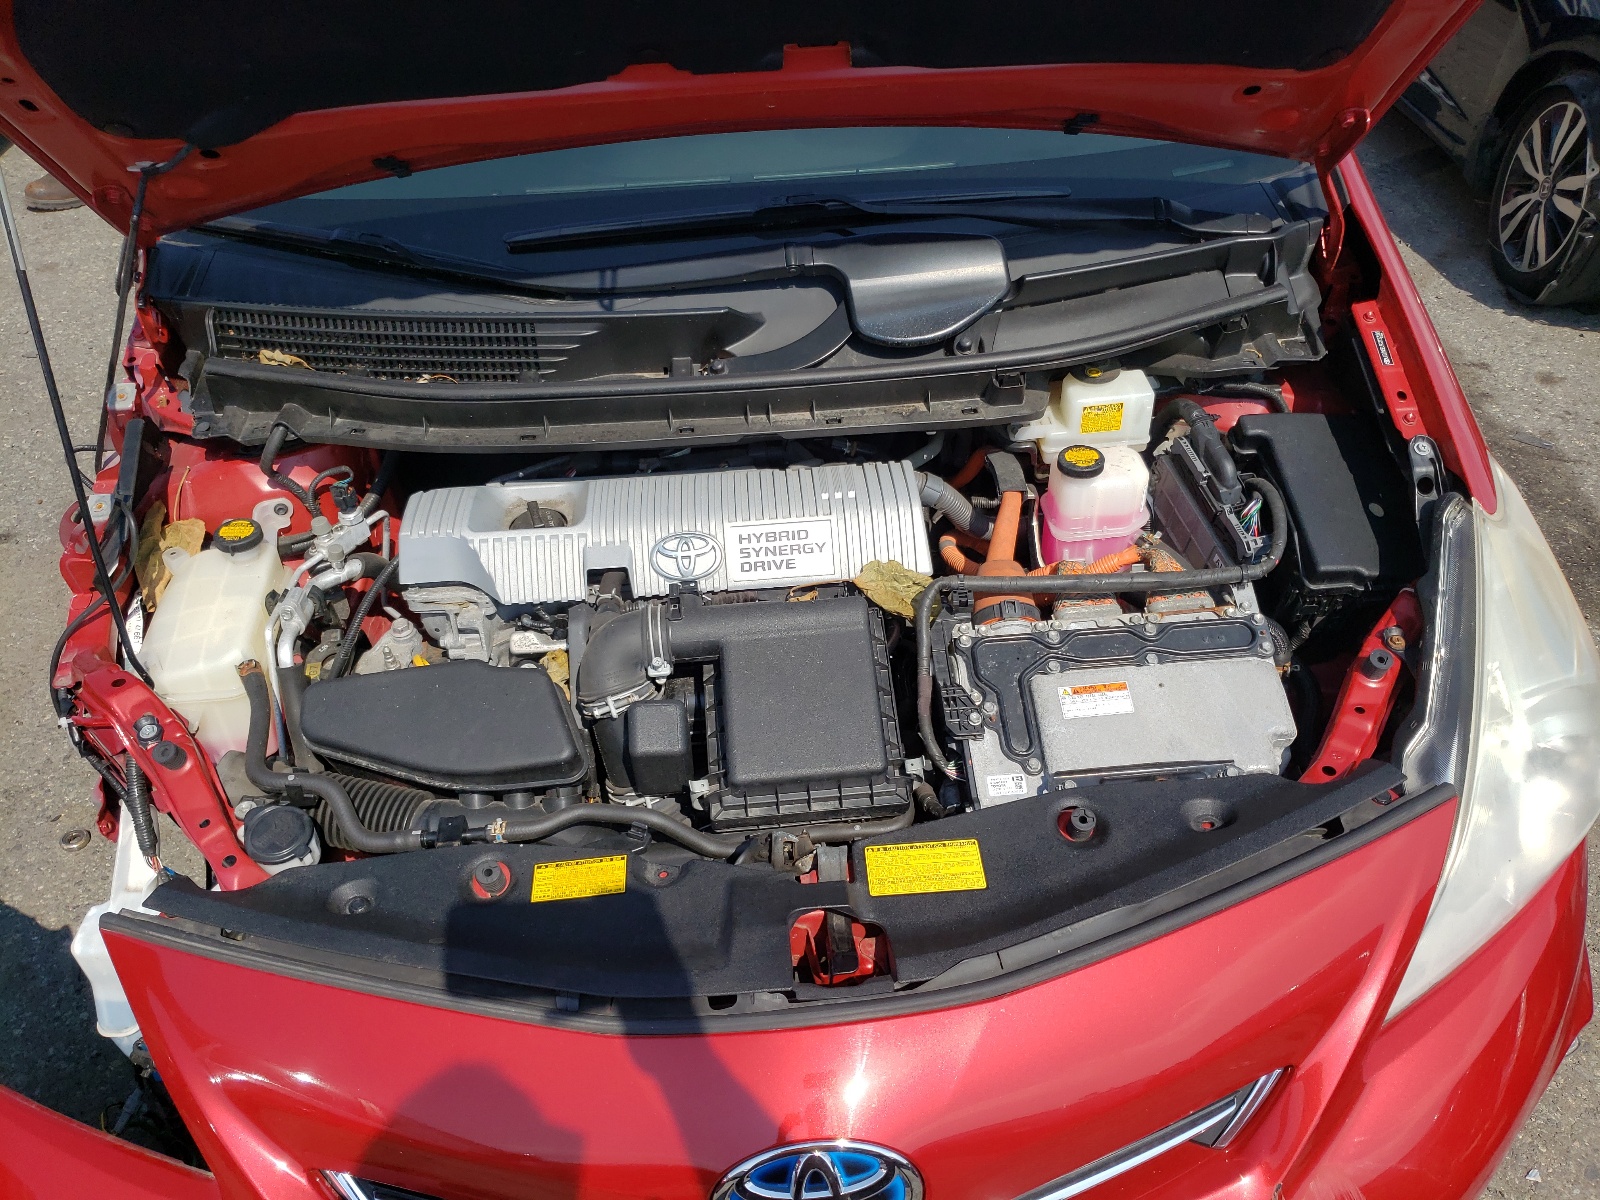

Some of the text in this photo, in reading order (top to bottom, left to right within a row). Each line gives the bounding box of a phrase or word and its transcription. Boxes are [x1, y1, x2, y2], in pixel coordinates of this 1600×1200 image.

[739, 530, 809, 545] HYBRID
[740, 542, 827, 558] SYNERGY
[741, 559, 797, 573] DRIVE
